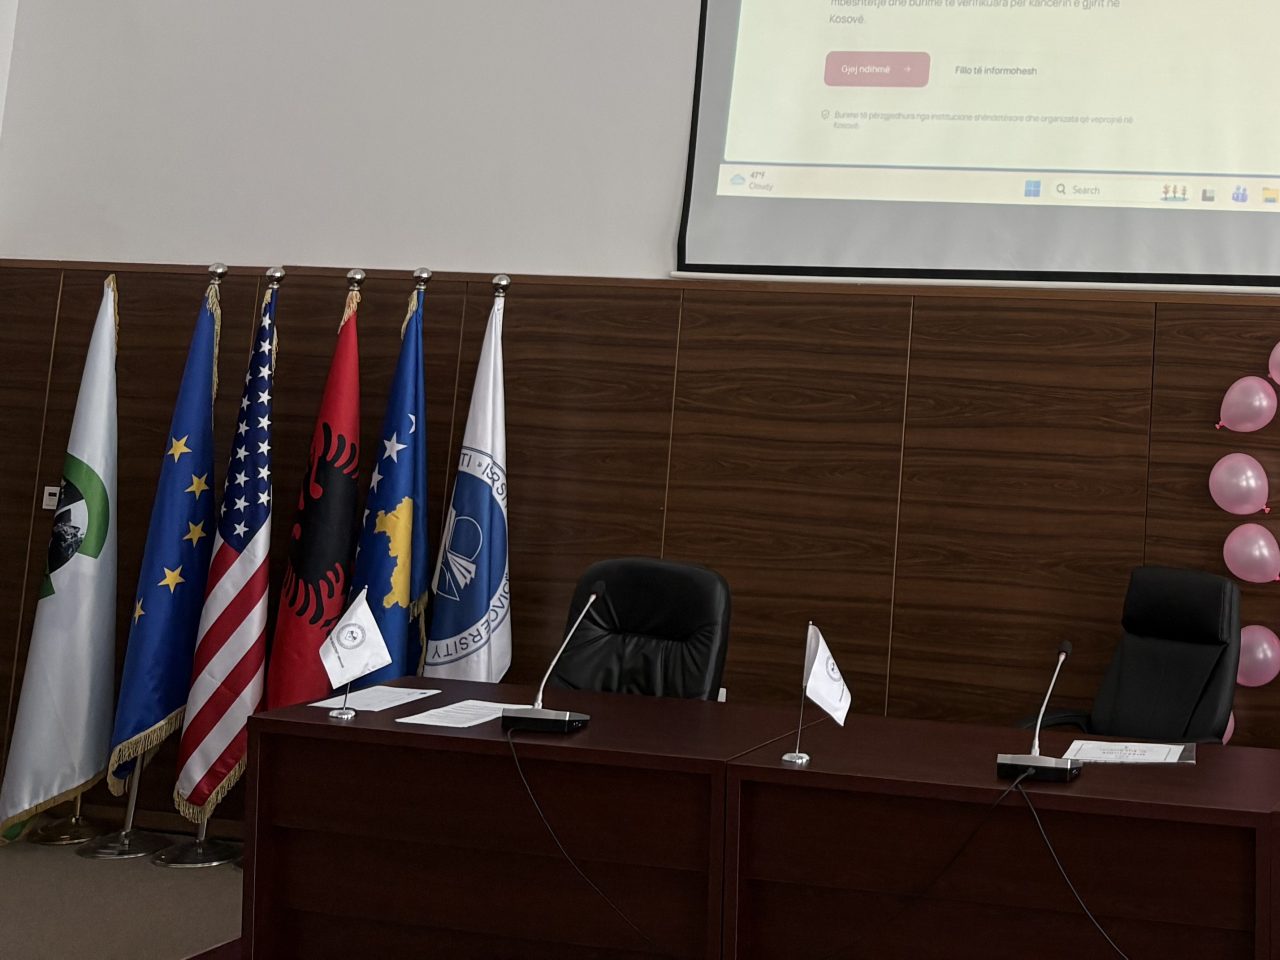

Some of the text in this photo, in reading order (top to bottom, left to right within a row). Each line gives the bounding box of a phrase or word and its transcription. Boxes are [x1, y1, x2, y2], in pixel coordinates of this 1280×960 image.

[954, 65, 972, 75] Fillo
[984, 66, 1038, 76] informohesh
[1072, 185, 1100, 195] Search
